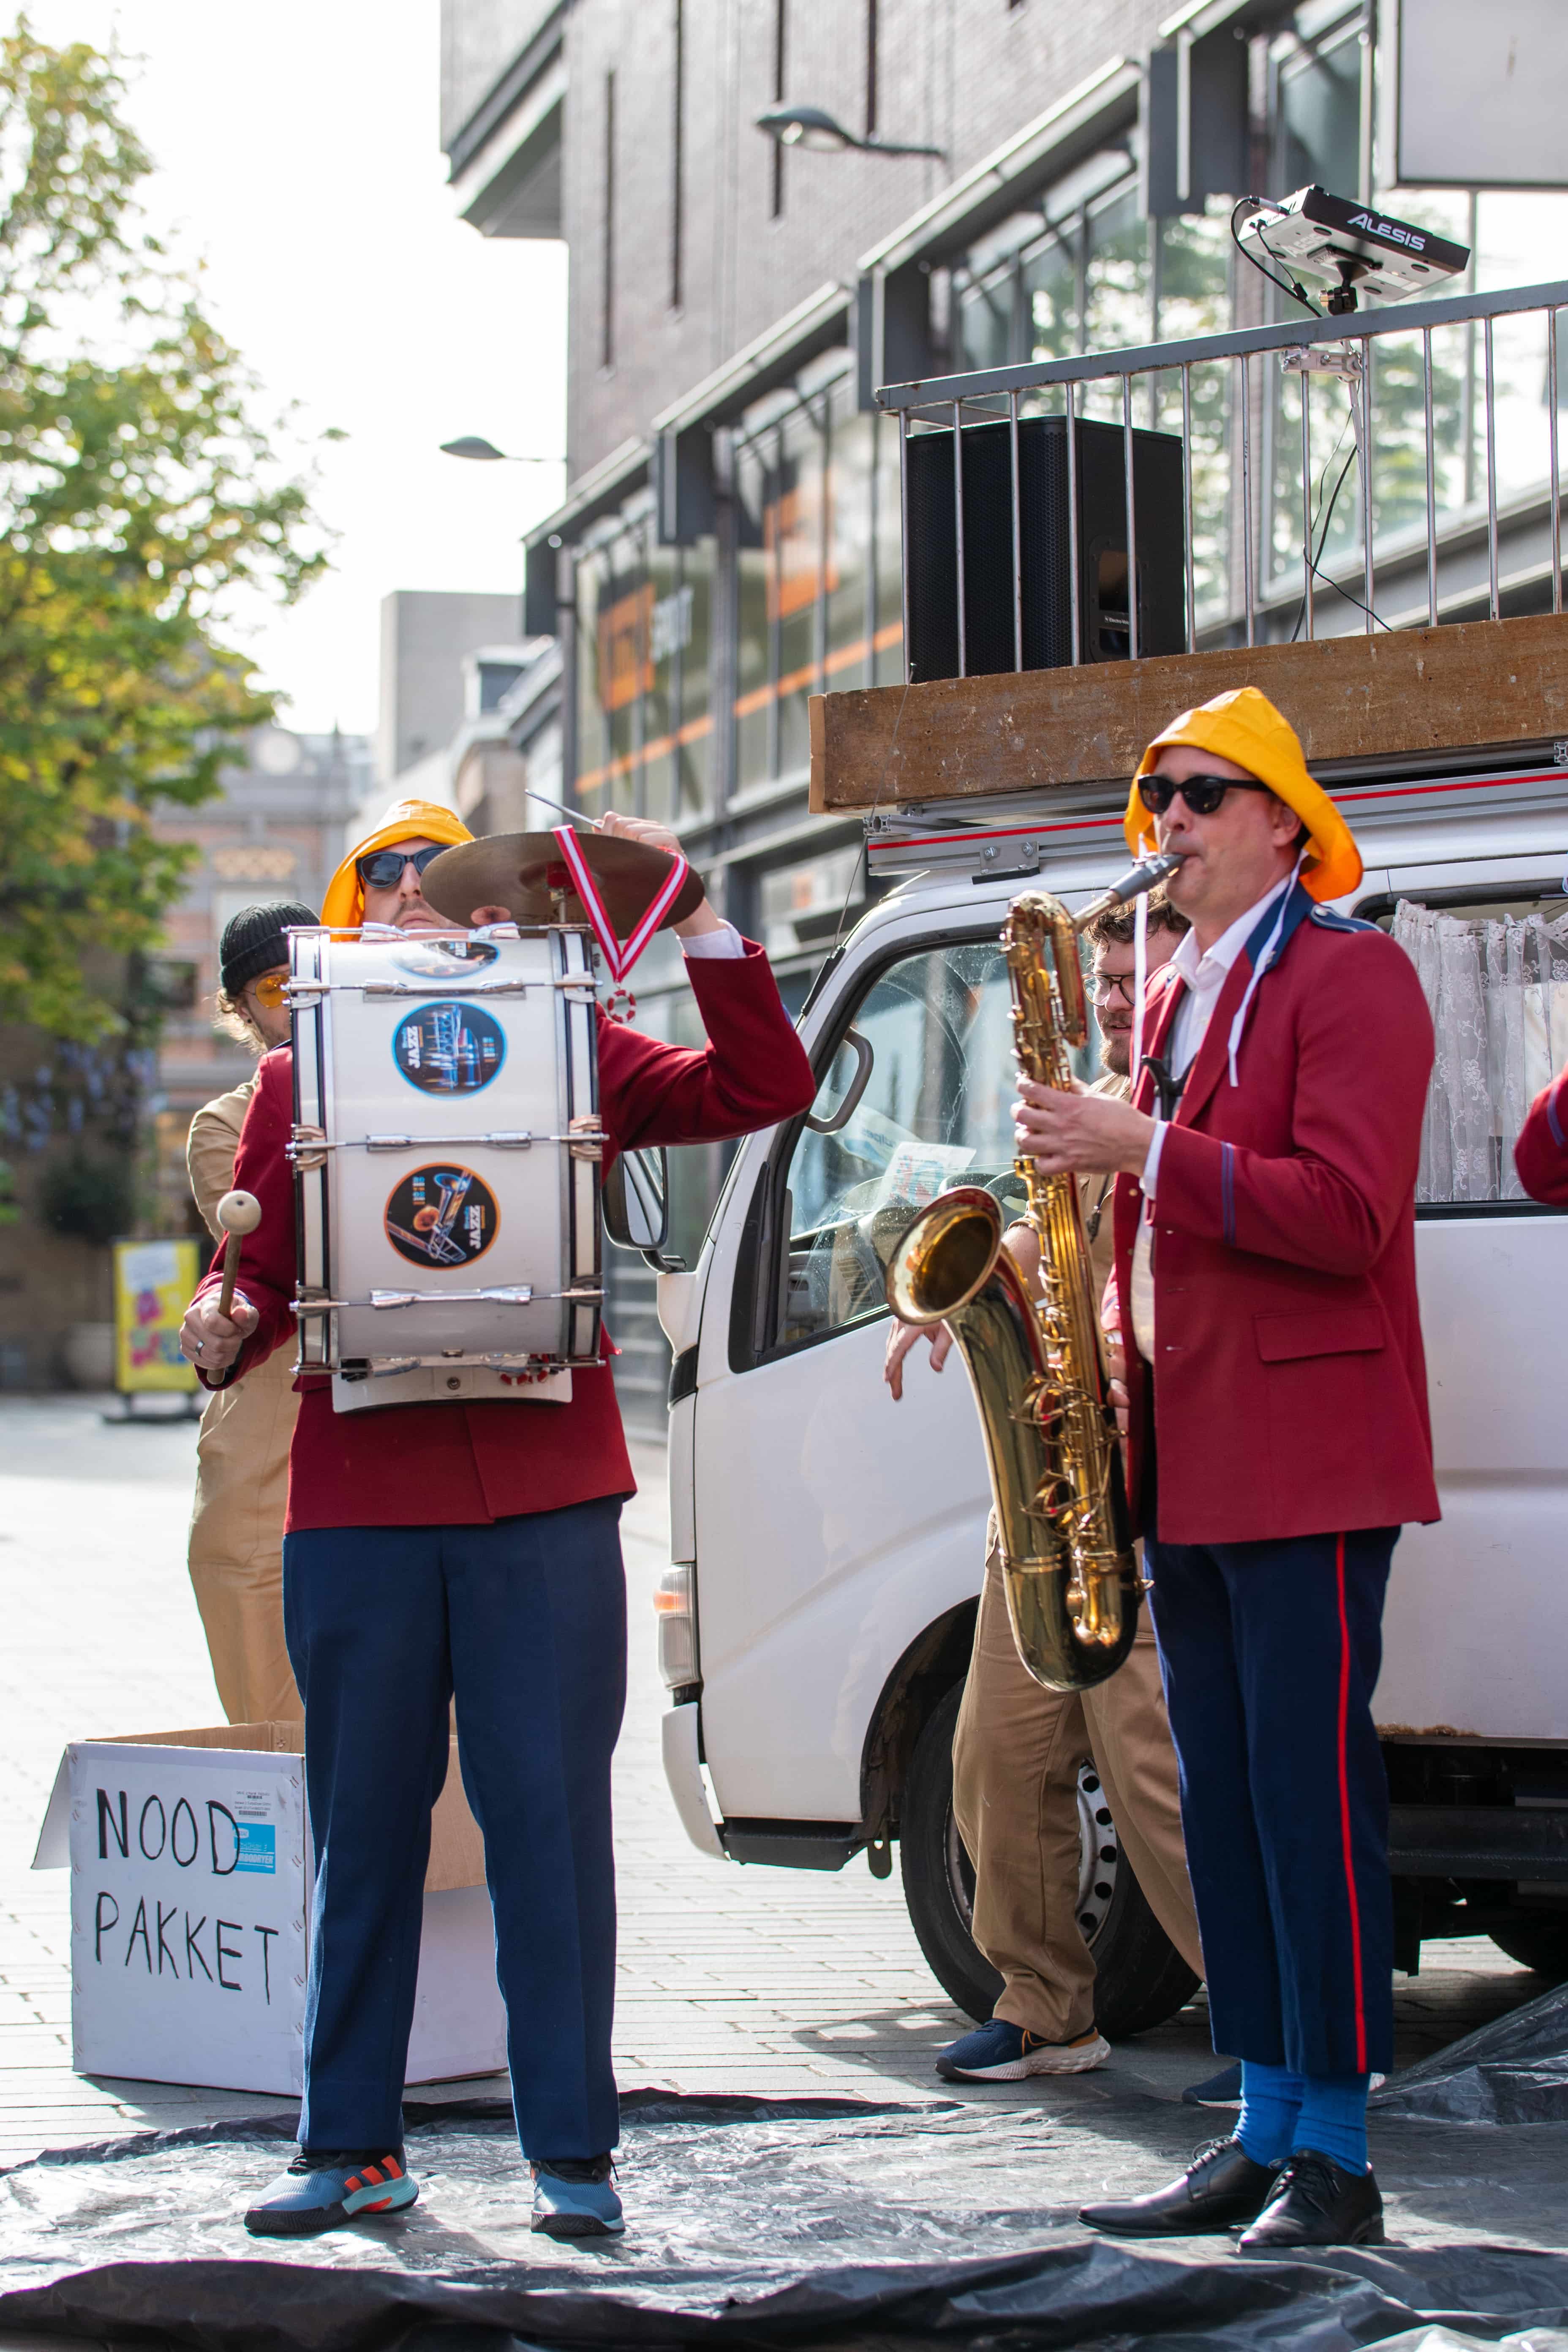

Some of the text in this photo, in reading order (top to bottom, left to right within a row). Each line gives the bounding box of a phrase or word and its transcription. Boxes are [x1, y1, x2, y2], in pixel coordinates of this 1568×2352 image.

[1347, 213, 1426, 251] ALESIS
[407, 1025, 421, 1069] JAZZ
[469, 1205, 481, 1250] JAZZ
[96, 1787, 240, 1875] NOOD
[95, 1891, 279, 2005] PAKKET
